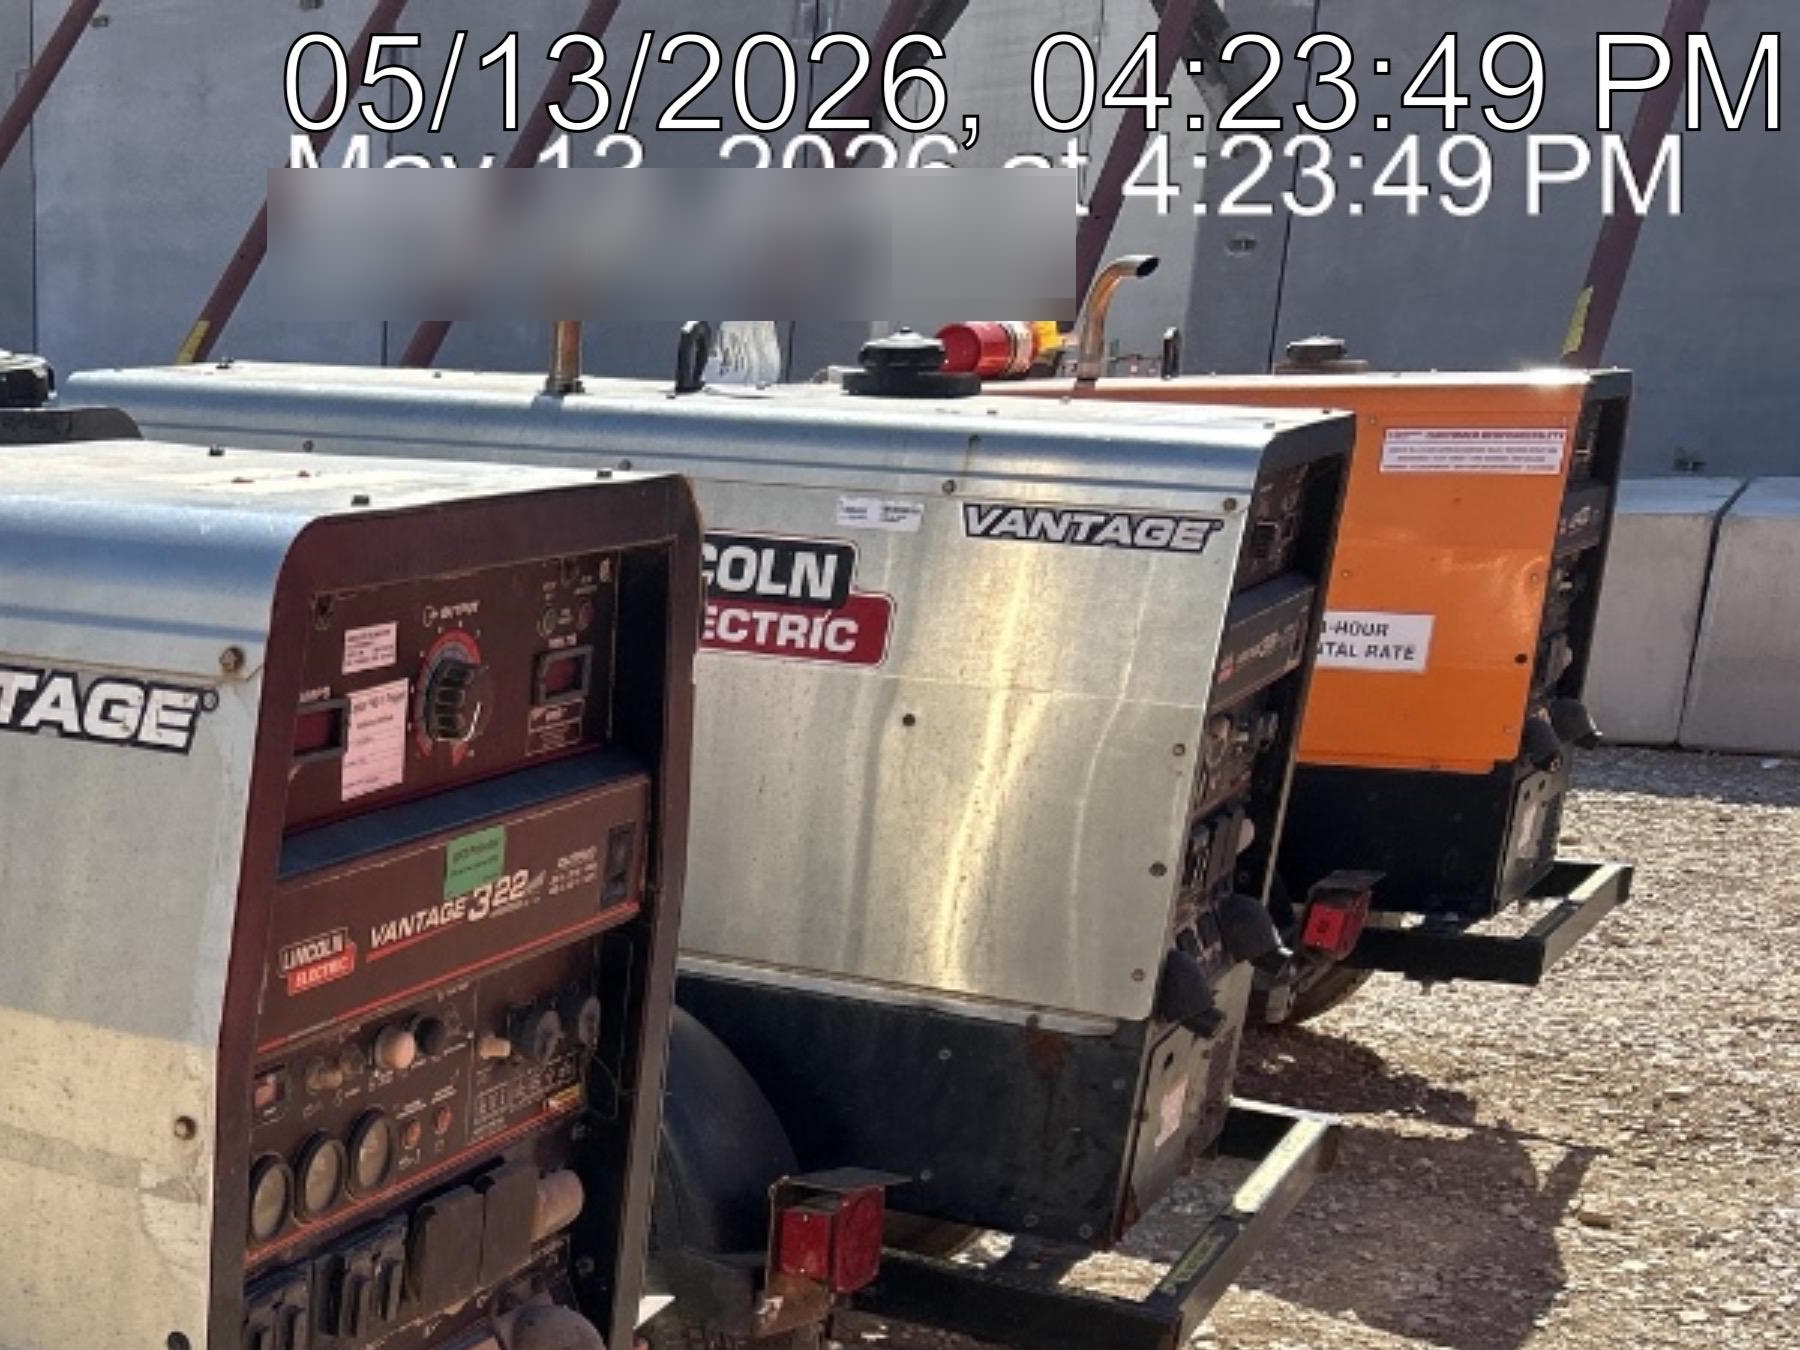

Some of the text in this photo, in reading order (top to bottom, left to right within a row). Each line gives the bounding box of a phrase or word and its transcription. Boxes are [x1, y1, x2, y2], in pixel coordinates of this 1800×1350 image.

[964, 502, 1213, 553] VANTAGE
[1364, 644, 1417, 661] RATE
[369, 896, 466, 949] VANTAGE
[466, 868, 529, 923] 322
[281, 930, 345, 970] LINCOLN
[294, 956, 350, 990] ELECTRIC
